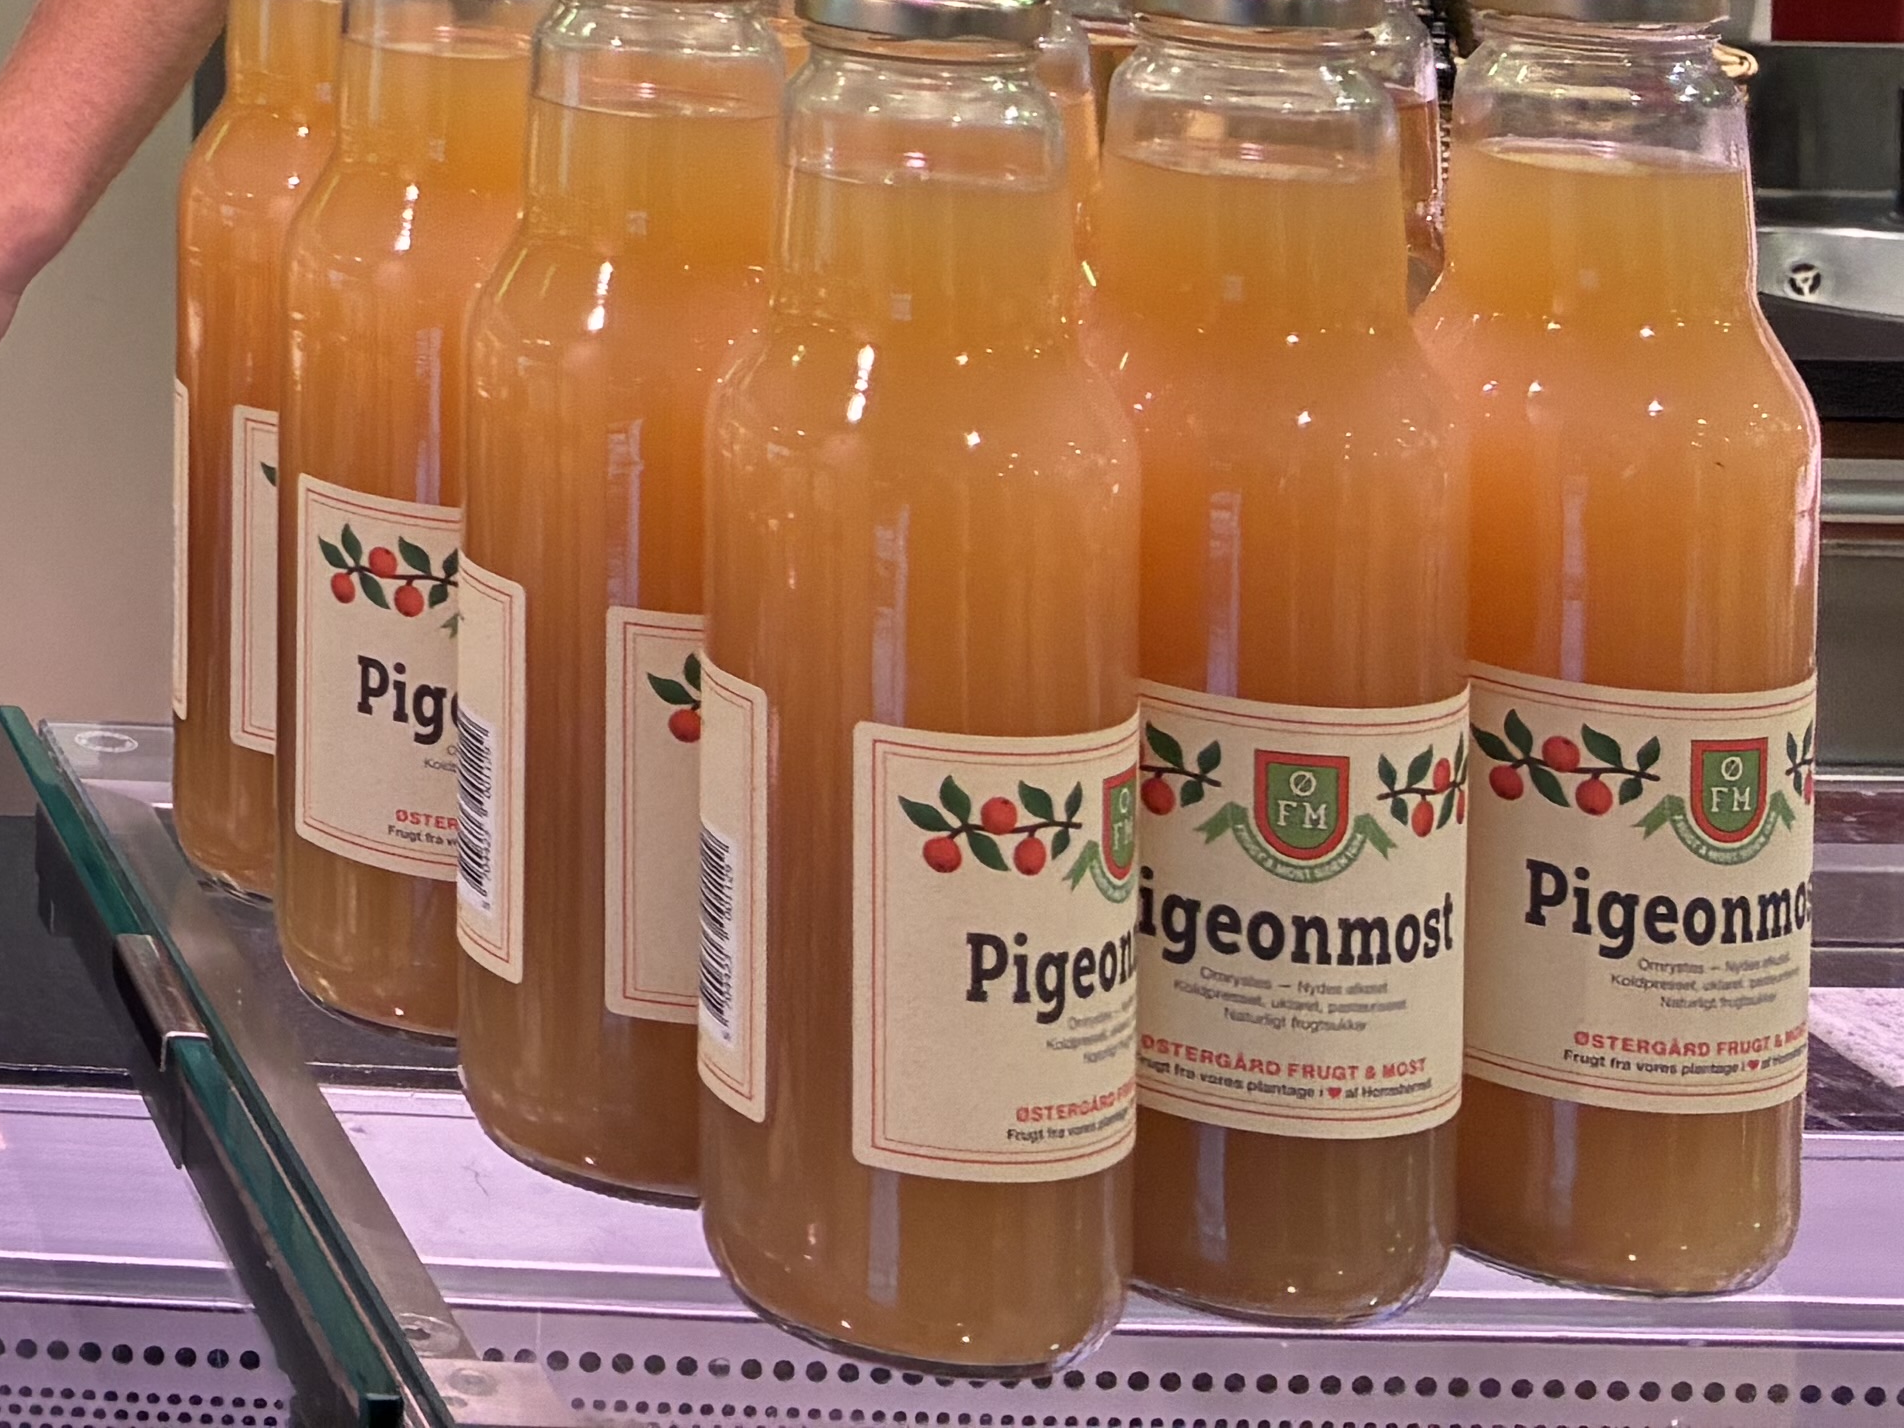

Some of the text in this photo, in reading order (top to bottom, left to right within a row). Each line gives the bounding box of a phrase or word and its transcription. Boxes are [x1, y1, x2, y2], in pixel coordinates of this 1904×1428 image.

[395, 808, 459, 831] ØSTER
[387, 824, 423, 843] Frugt
[425, 832, 444, 846] fra
[1136, 865, 1454, 966] igeonmost
[1524, 857, 1811, 960] Pigeonmo
[965, 924, 1136, 1025] Pigeon
[1223, 1007, 1287, 1030] Naturligt
[1573, 1030, 1711, 1058] ØSTERGÅRD
[1716, 1035, 1770, 1057] FRUGT
[1287, 1062, 1360, 1081] FRUGT
[1364, 1065, 1377, 1081] &
[1381, 1056, 1428, 1079] MOST
[1563, 1049, 1606, 1068] Frugt
[1609, 1056, 1632, 1071] fra
[1680, 1061, 1739, 1077] plantage
[1174, 1062, 1196, 1081] fra
[1246, 1078, 1315, 1100] plantage
